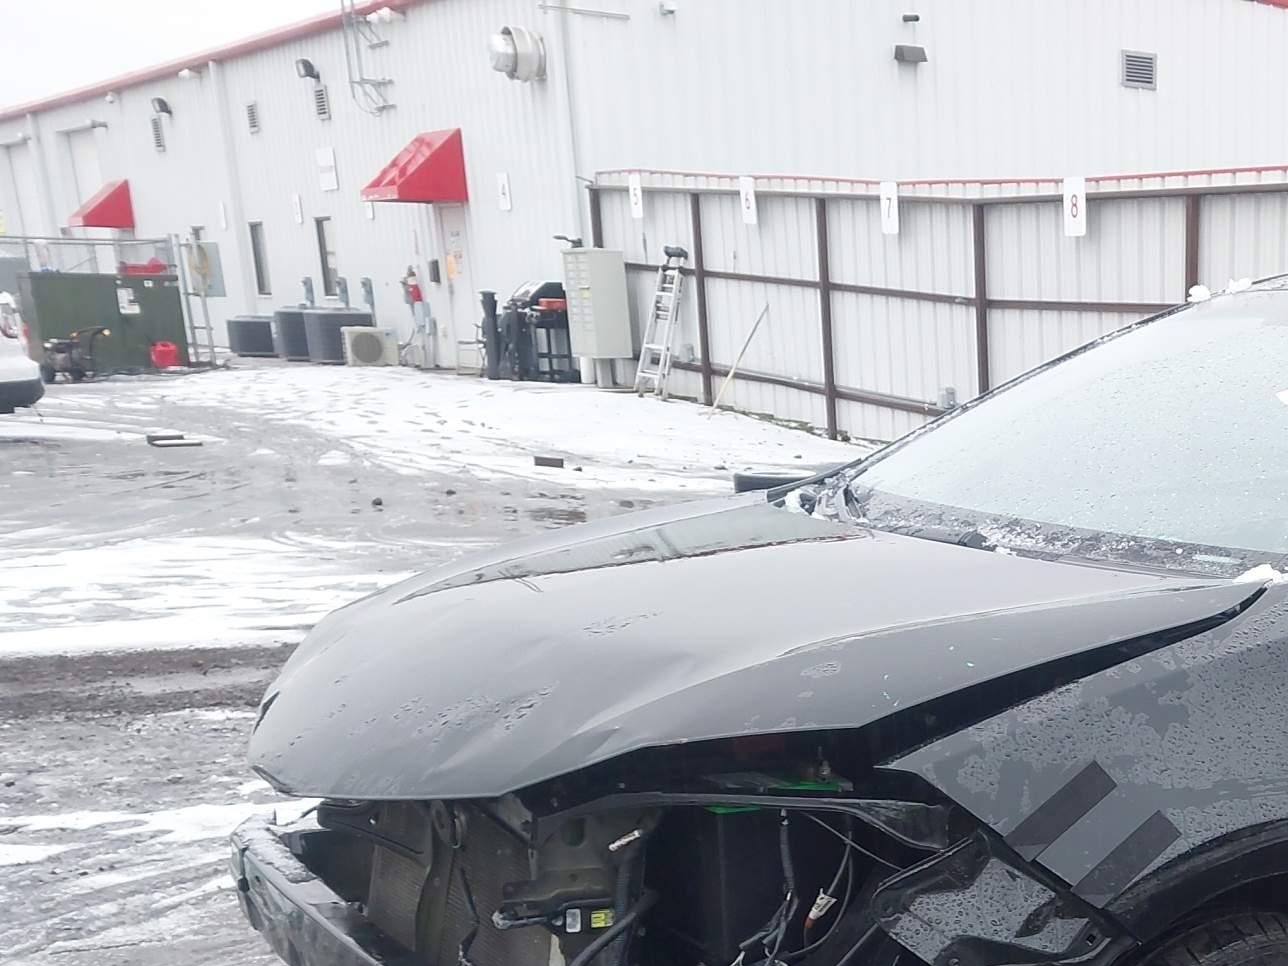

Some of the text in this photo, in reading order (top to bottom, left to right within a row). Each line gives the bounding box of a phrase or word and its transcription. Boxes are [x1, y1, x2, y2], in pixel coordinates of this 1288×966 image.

[633, 187, 639, 206] 5
[745, 192, 751, 210] 6
[1070, 194, 1079, 218] 8
[885, 197, 892, 219] 7
